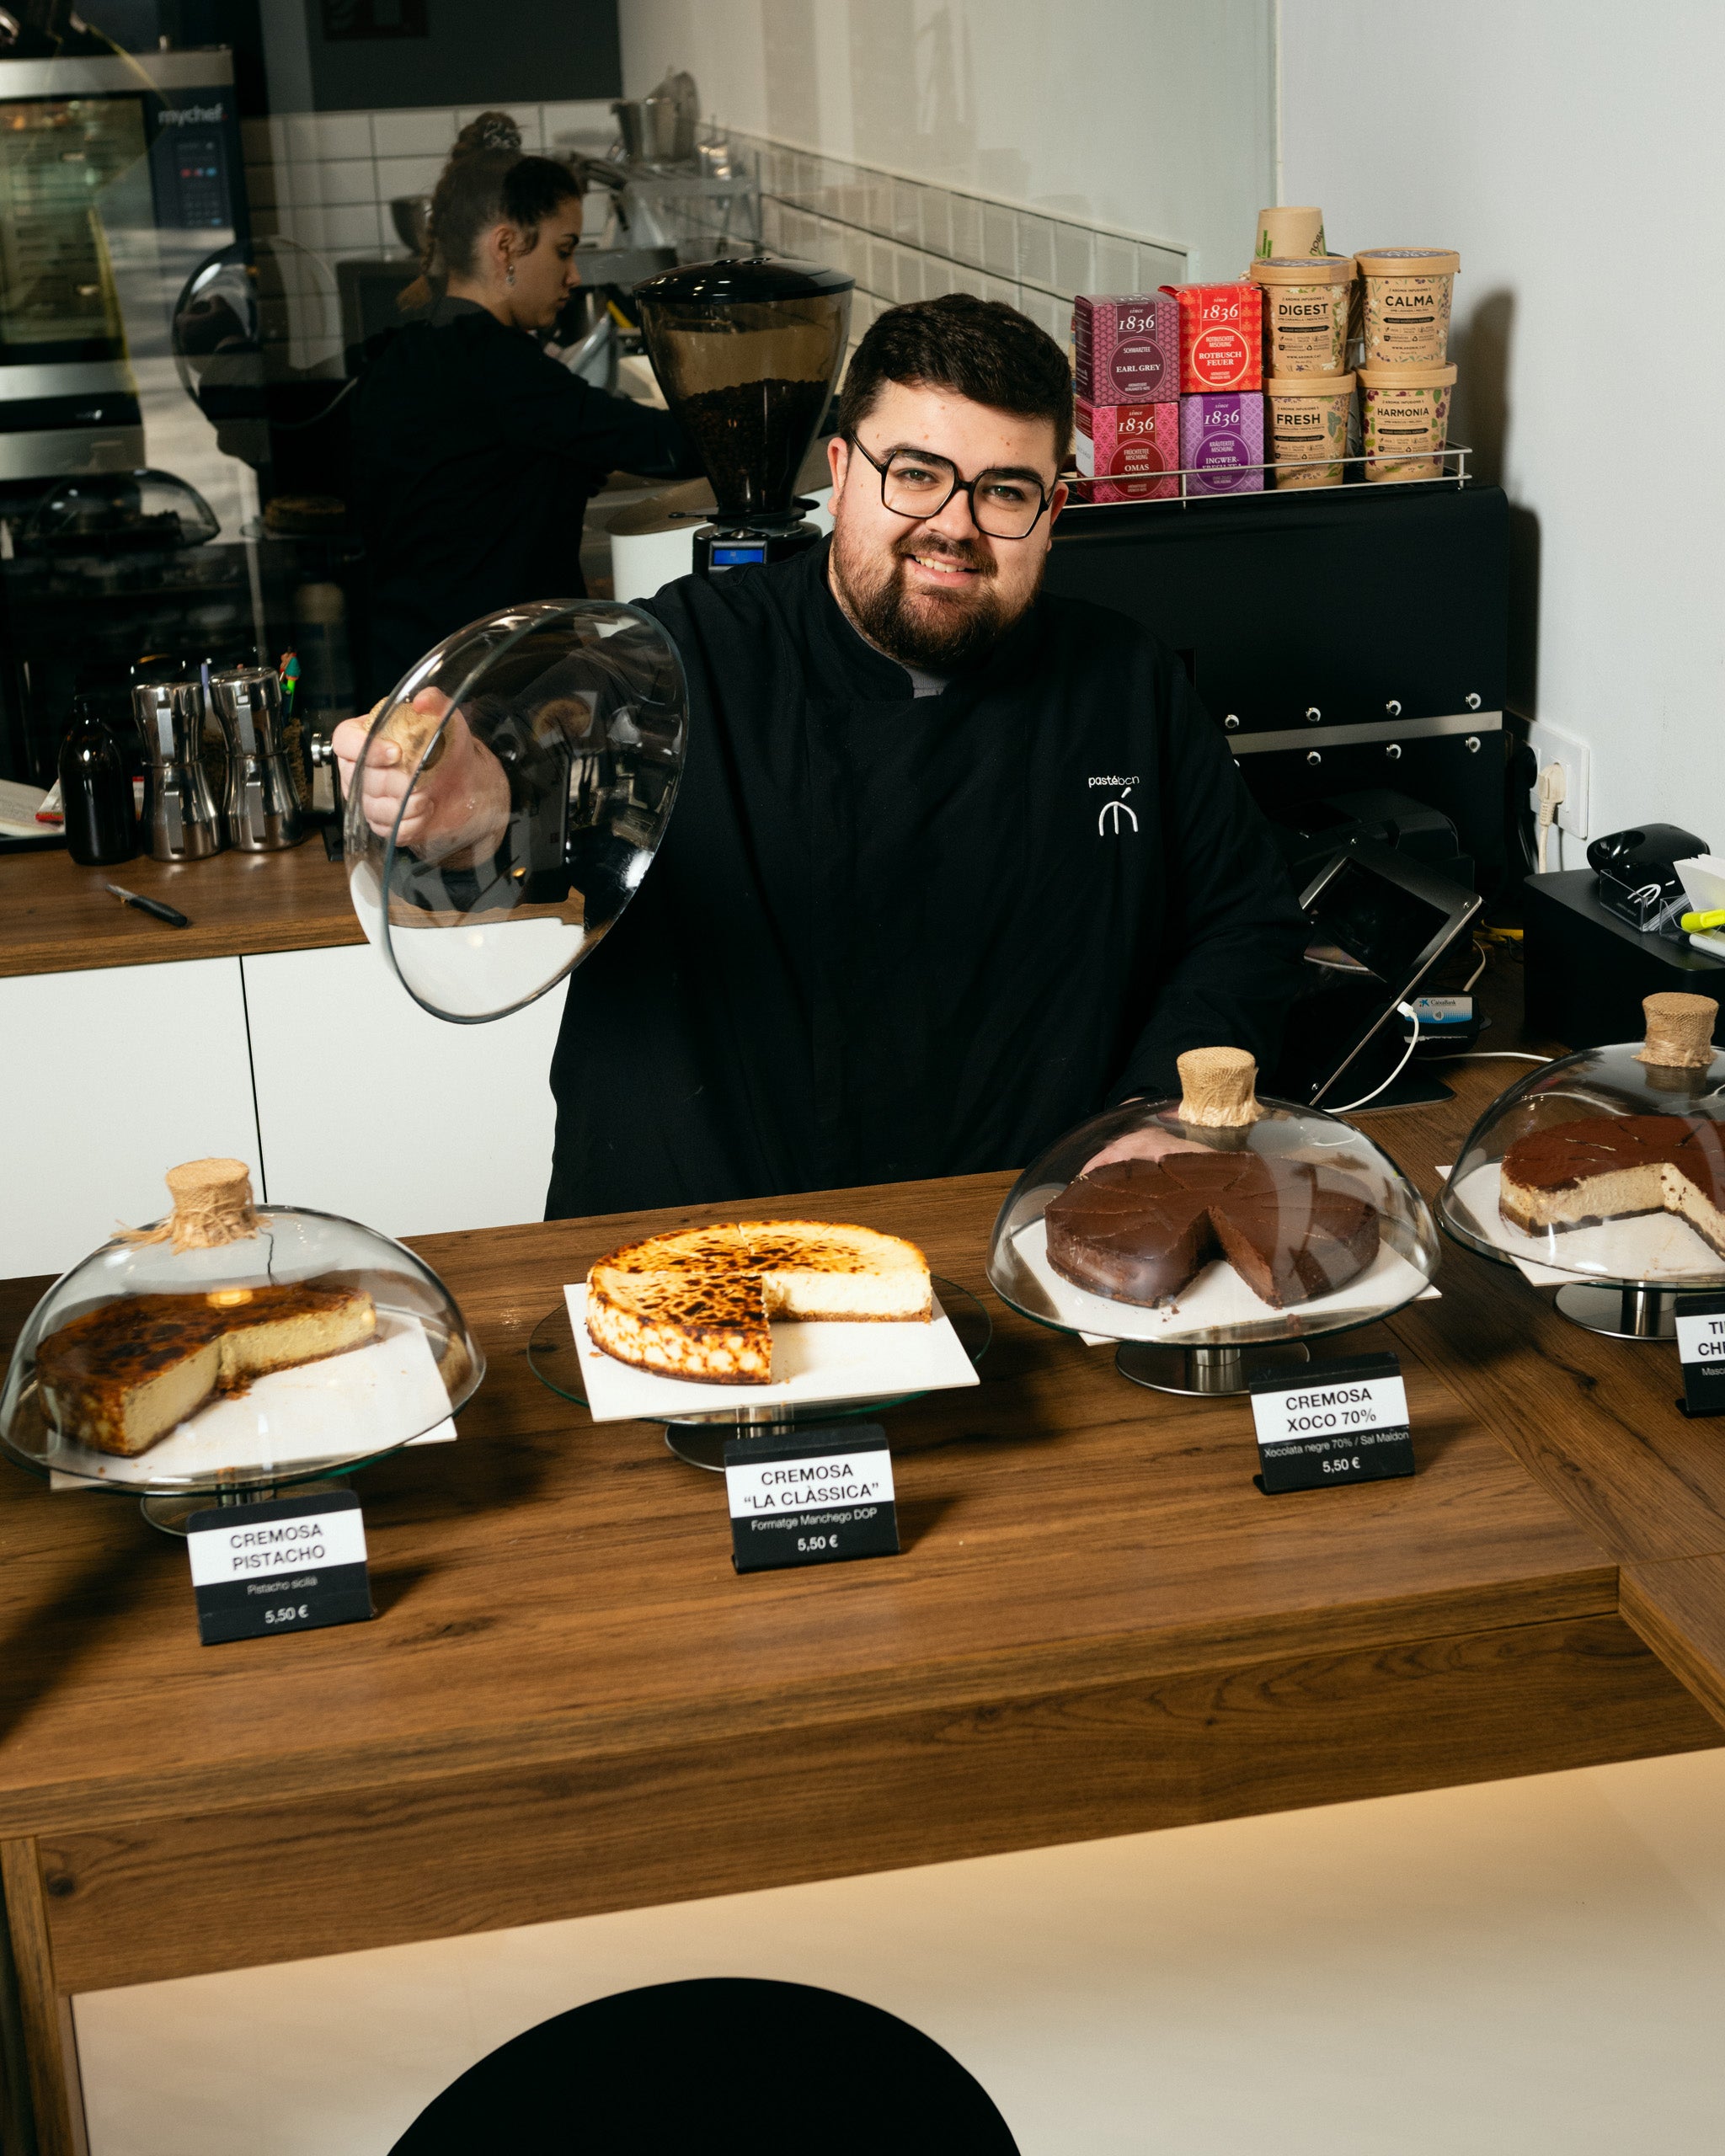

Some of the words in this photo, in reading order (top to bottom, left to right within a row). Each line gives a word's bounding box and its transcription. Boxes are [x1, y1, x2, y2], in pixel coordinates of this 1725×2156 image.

[1279, 303, 1328, 316] DIGEST
[1385, 295, 1434, 307] CALMA
[1203, 303, 1239, 322] 1836
[1118, 314, 1155, 334] 1836
[1199, 351, 1242, 360] ROTBUSCH
[1204, 408, 1240, 428] 1836
[1276, 414, 1321, 424] FRESH
[1377, 408, 1429, 417] HARMONIA
[1119, 416, 1155, 435] 1836
[1205, 456, 1239, 465] INGWER-
[1088, 775, 1140, 788] pastébcn
[1708, 1321, 1725, 1335] TI
[1285, 1388, 1372, 1411] CREMOSA
[1287, 1413, 1337, 1433] XOCO
[1341, 1408, 1376, 1425] 70%
[1264, 1444, 1304, 1459] Xocolata
[1305, 1442, 1331, 1454] negre
[1332, 1438, 1353, 1449] 70%
[1359, 1434, 1375, 1446] Sal
[1375, 1431, 1409, 1444] Maldon
[1322, 1459, 1349, 1474] 5,50
[1351, 1456, 1361, 1470] €
[761, 1464, 853, 1486] CREMOSA
[750, 1516, 798, 1531] Formatge
[800, 1510, 852, 1526] Manchego
[854, 1507, 878, 1520] DOP
[230, 1524, 323, 1549] CREMOSA
[797, 1538, 826, 1552] 5,50
[829, 1534, 839, 1548] €
[232, 1545, 326, 1571] PISTACHO
[247, 1581, 290, 1595] Pistacho
[264, 1607, 296, 1625] 5,50
[298, 1604, 309, 1619] €
